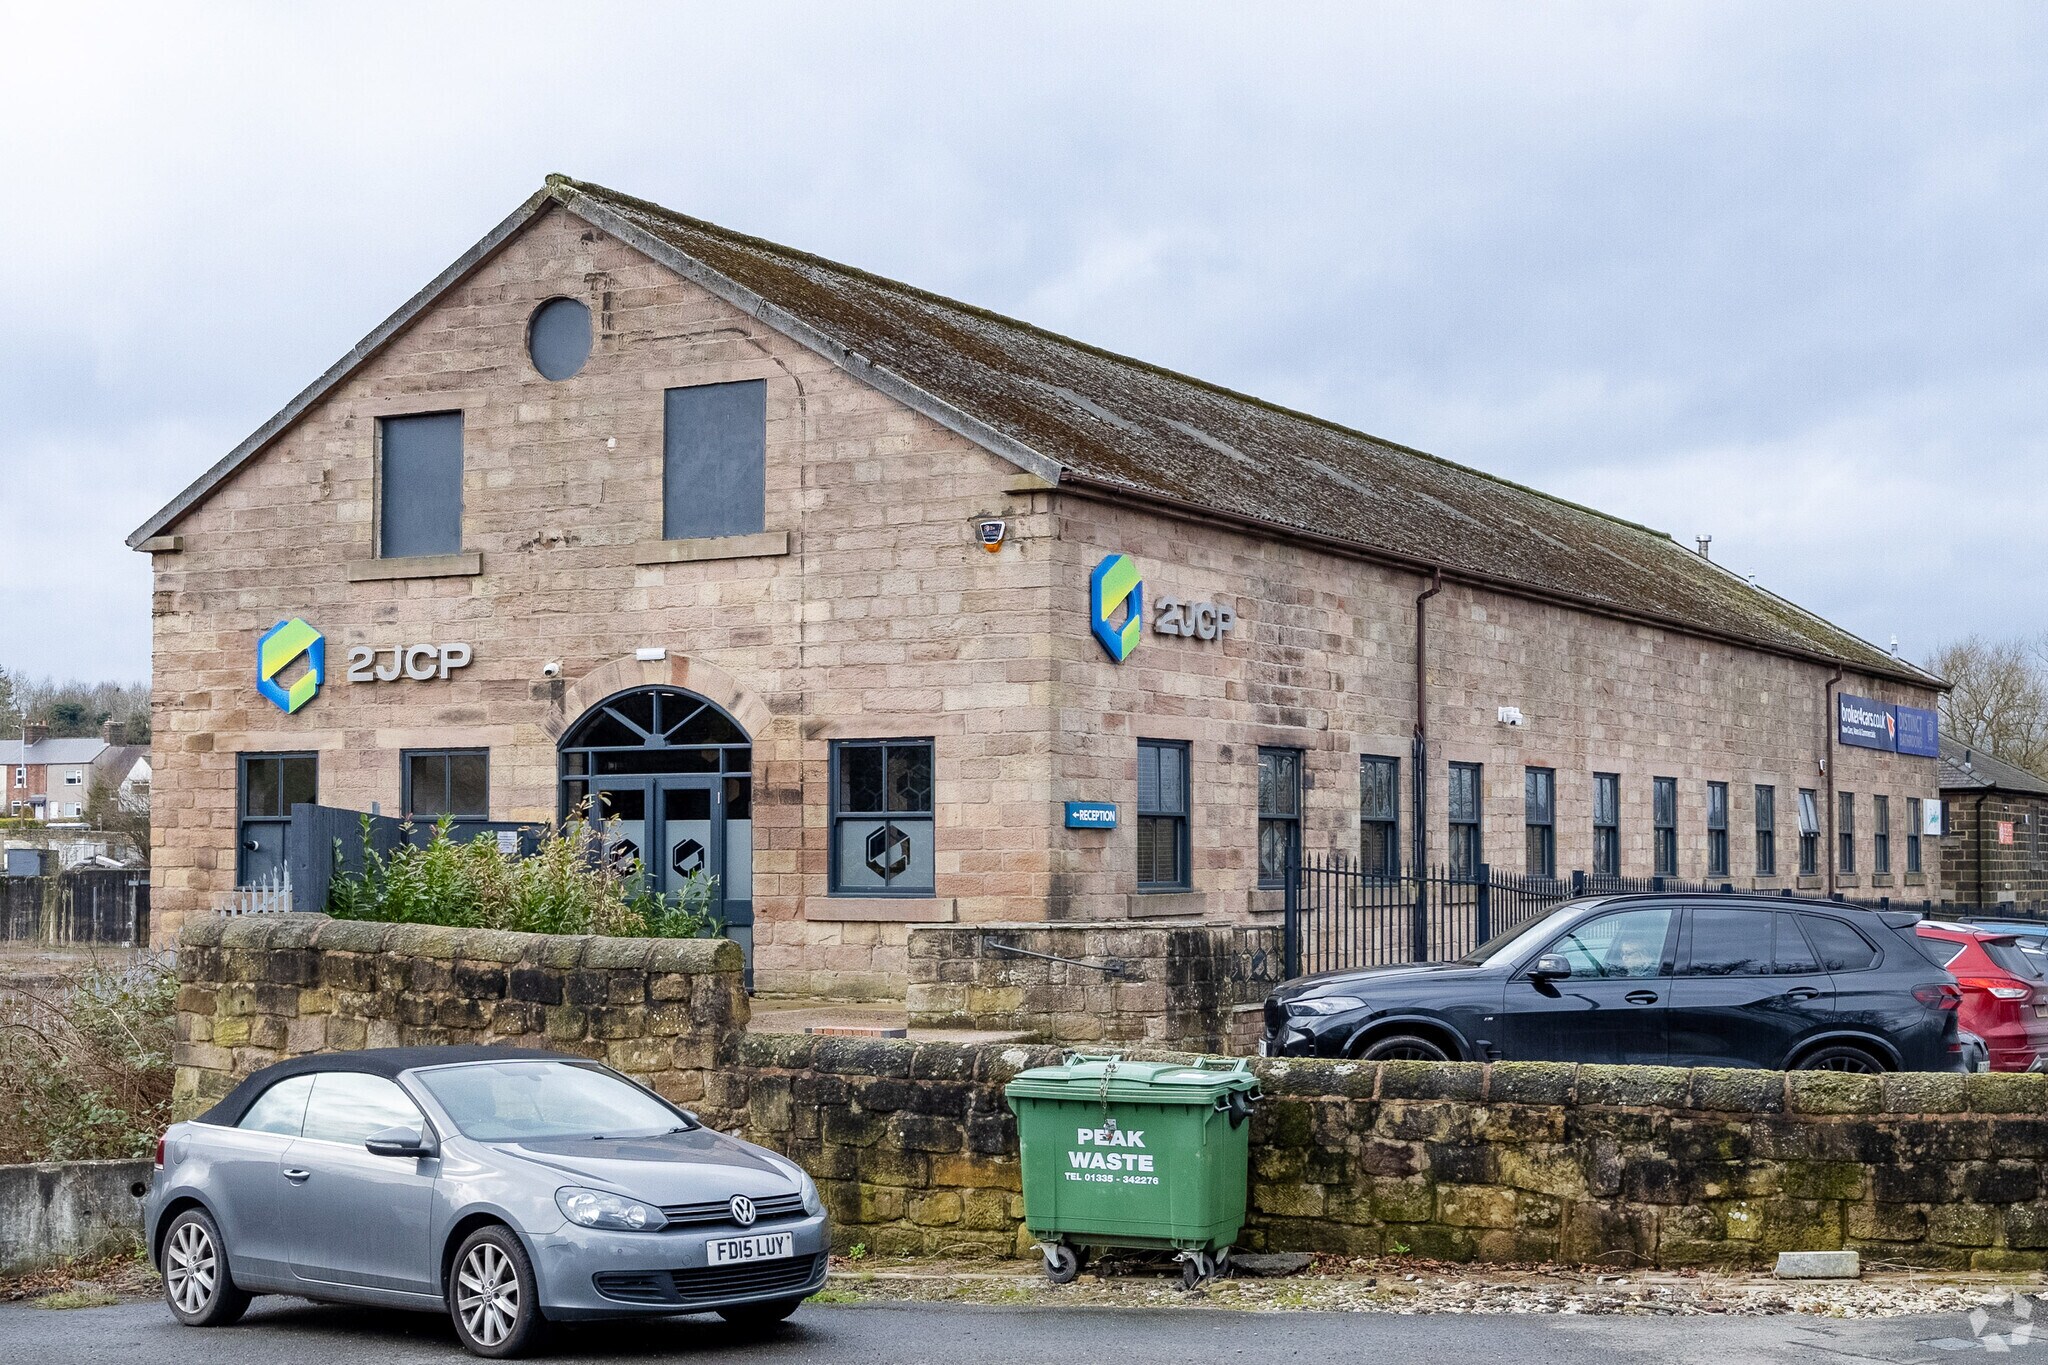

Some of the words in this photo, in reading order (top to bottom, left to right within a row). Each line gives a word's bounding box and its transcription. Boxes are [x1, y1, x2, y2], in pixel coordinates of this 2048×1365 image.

[1153, 594, 1237, 641] 2JCP
[347, 643, 473, 681] 2JCP
[1841, 702, 1886, 729] broker4cars.co.uk
[1079, 809, 1116, 822] RECEPTION
[1077, 1128, 1146, 1148] PEAK
[1068, 1151, 1154, 1172] WASTE
[1064, 1172, 1082, 1181] TEL
[1084, 1173, 1114, 1183] 01335
[1122, 1175, 1159, 1185] 342276
[717, 1240, 753, 1261] FD15
[756, 1236, 784, 1257] LUY
